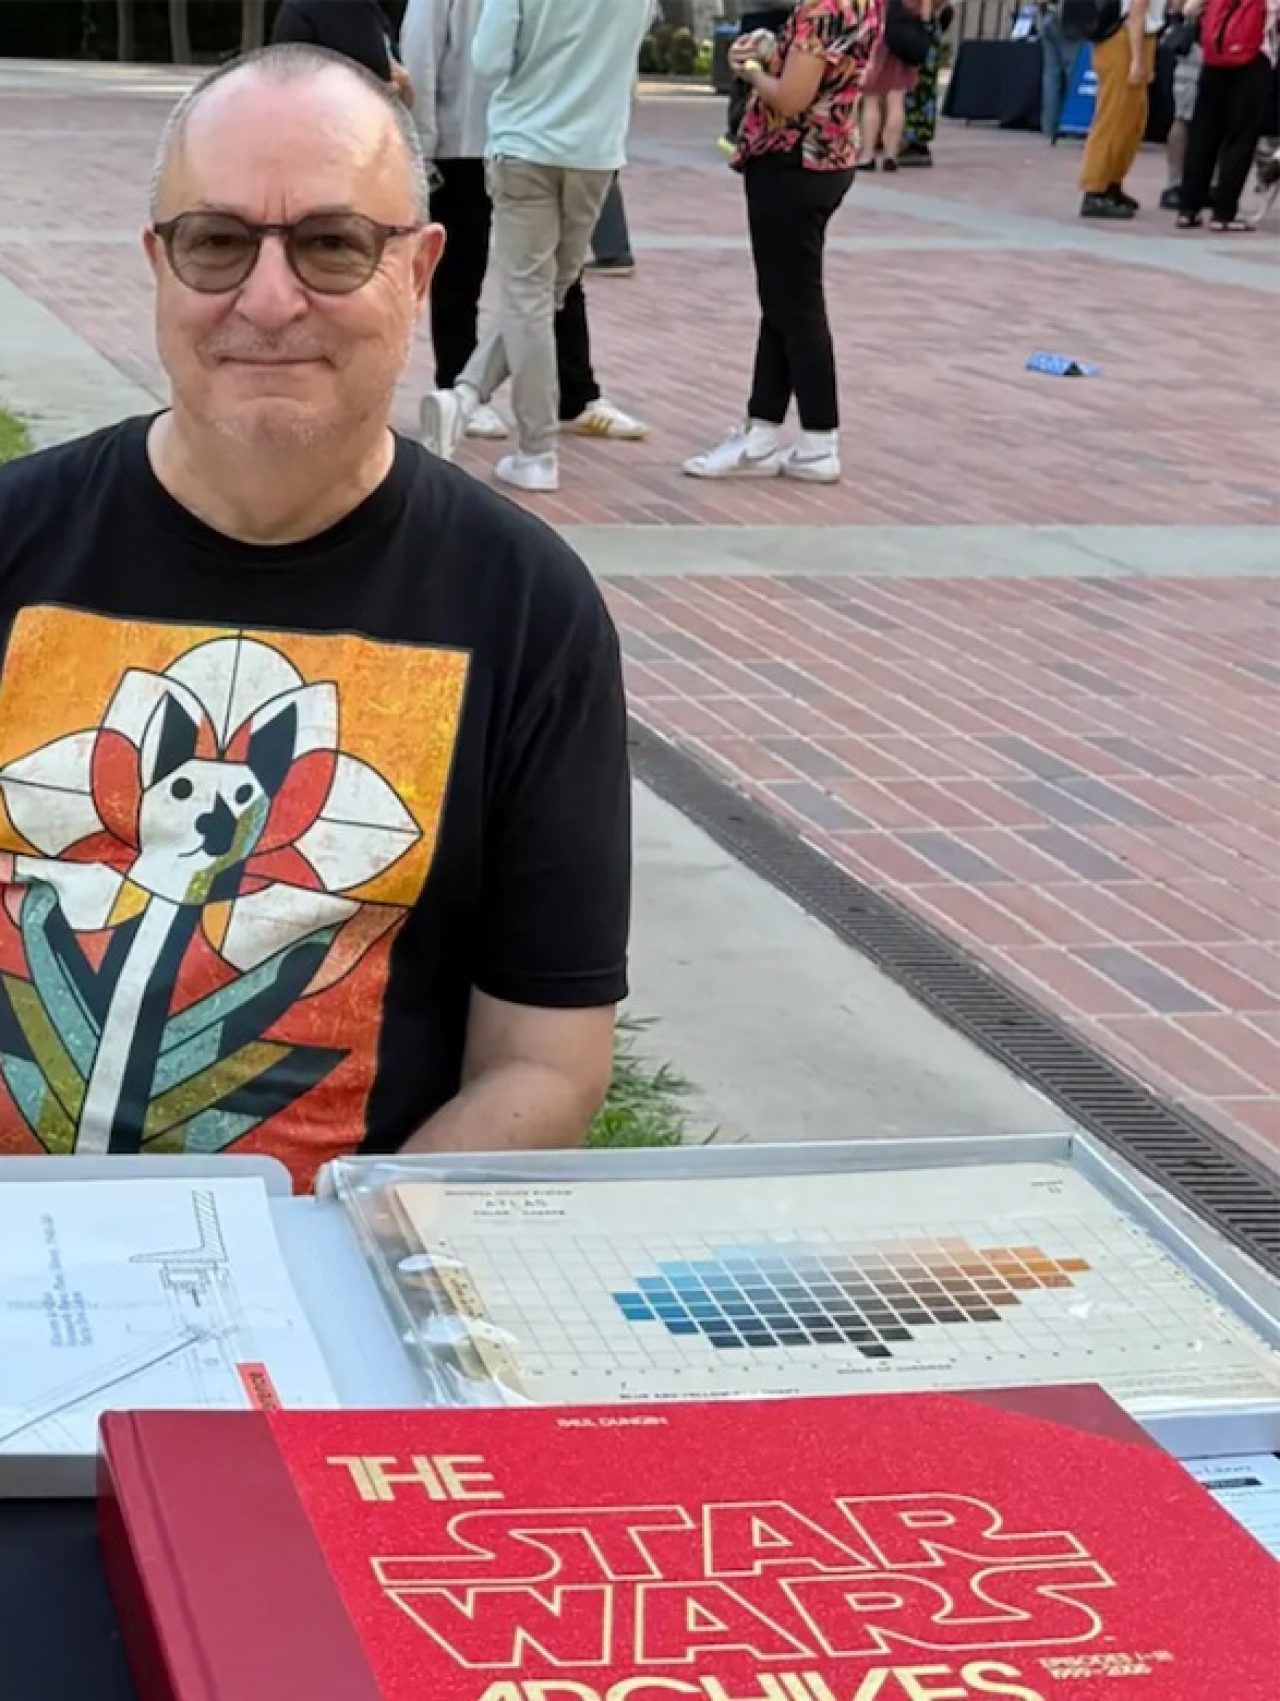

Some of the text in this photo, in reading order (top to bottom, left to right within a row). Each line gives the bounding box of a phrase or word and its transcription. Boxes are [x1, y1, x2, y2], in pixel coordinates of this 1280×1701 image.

[325, 1455, 504, 1501] THE
[370, 1493, 1090, 1585] STAR
[383, 1561, 1115, 1668] WARS
